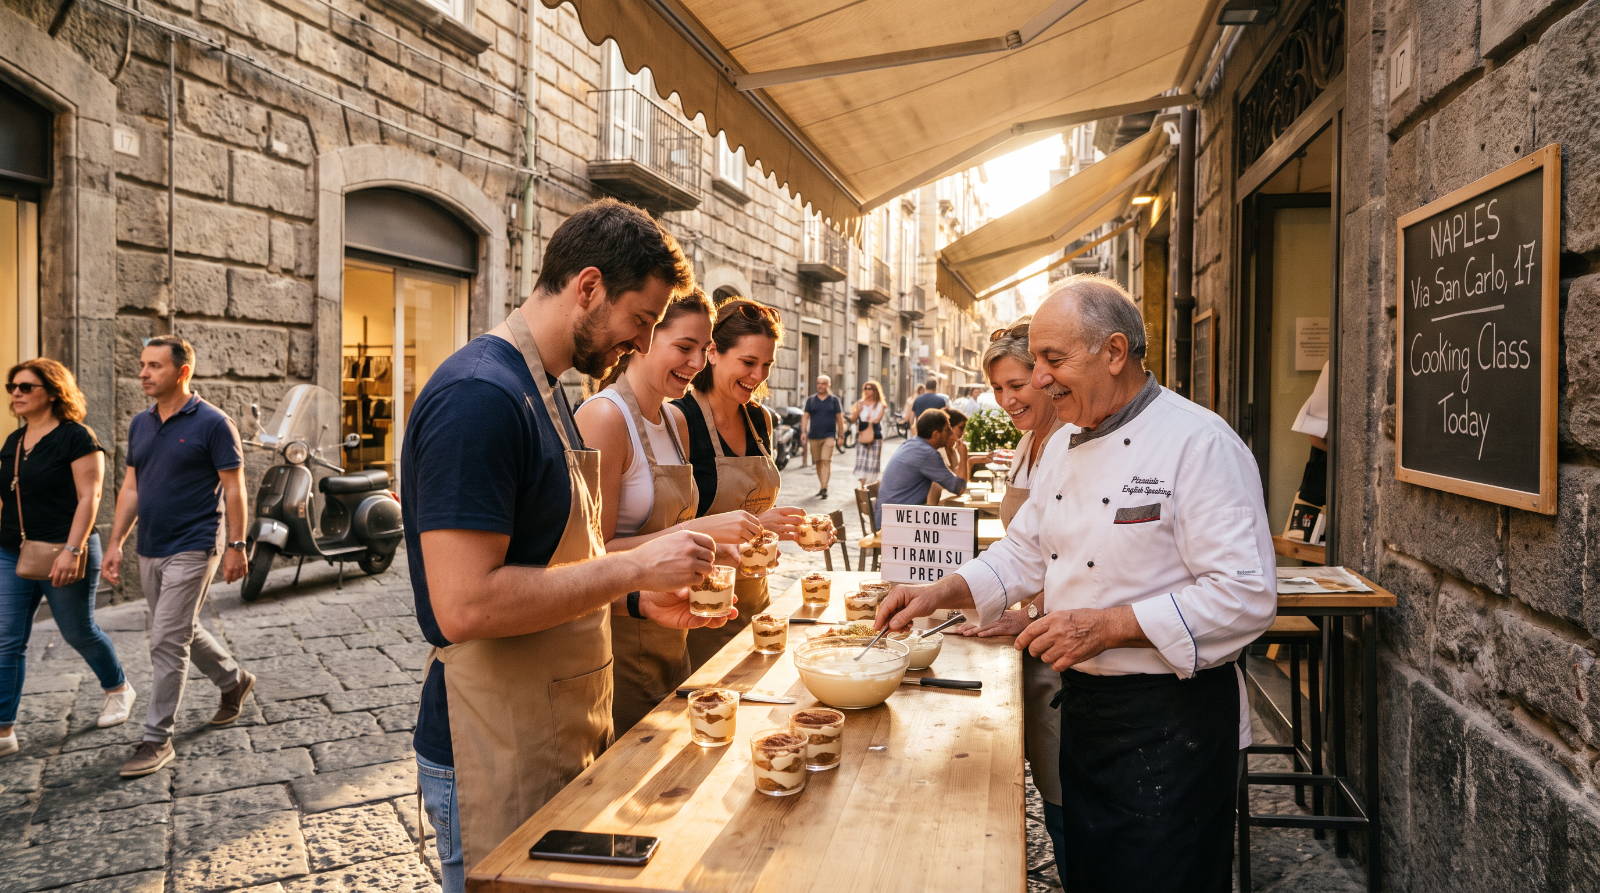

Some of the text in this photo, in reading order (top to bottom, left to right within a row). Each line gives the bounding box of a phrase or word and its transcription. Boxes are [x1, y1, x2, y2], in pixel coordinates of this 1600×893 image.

[1395, 49, 1406, 89] 17
[121, 134, 133, 150] 17
[1430, 198, 1500, 260] NAPLES
[1410, 239, 1536, 310] Via San Carlo, 17
[1410, 321, 1531, 394] Cooking Class
[1437, 392, 1491, 461] Today
[1121, 484, 1172, 499] English Speaking
[896, 509, 958, 526] WELCOME
[914, 529, 940, 544] AND
[892, 546, 962, 565] TIRAMISU
[910, 566, 944, 581] PREP
